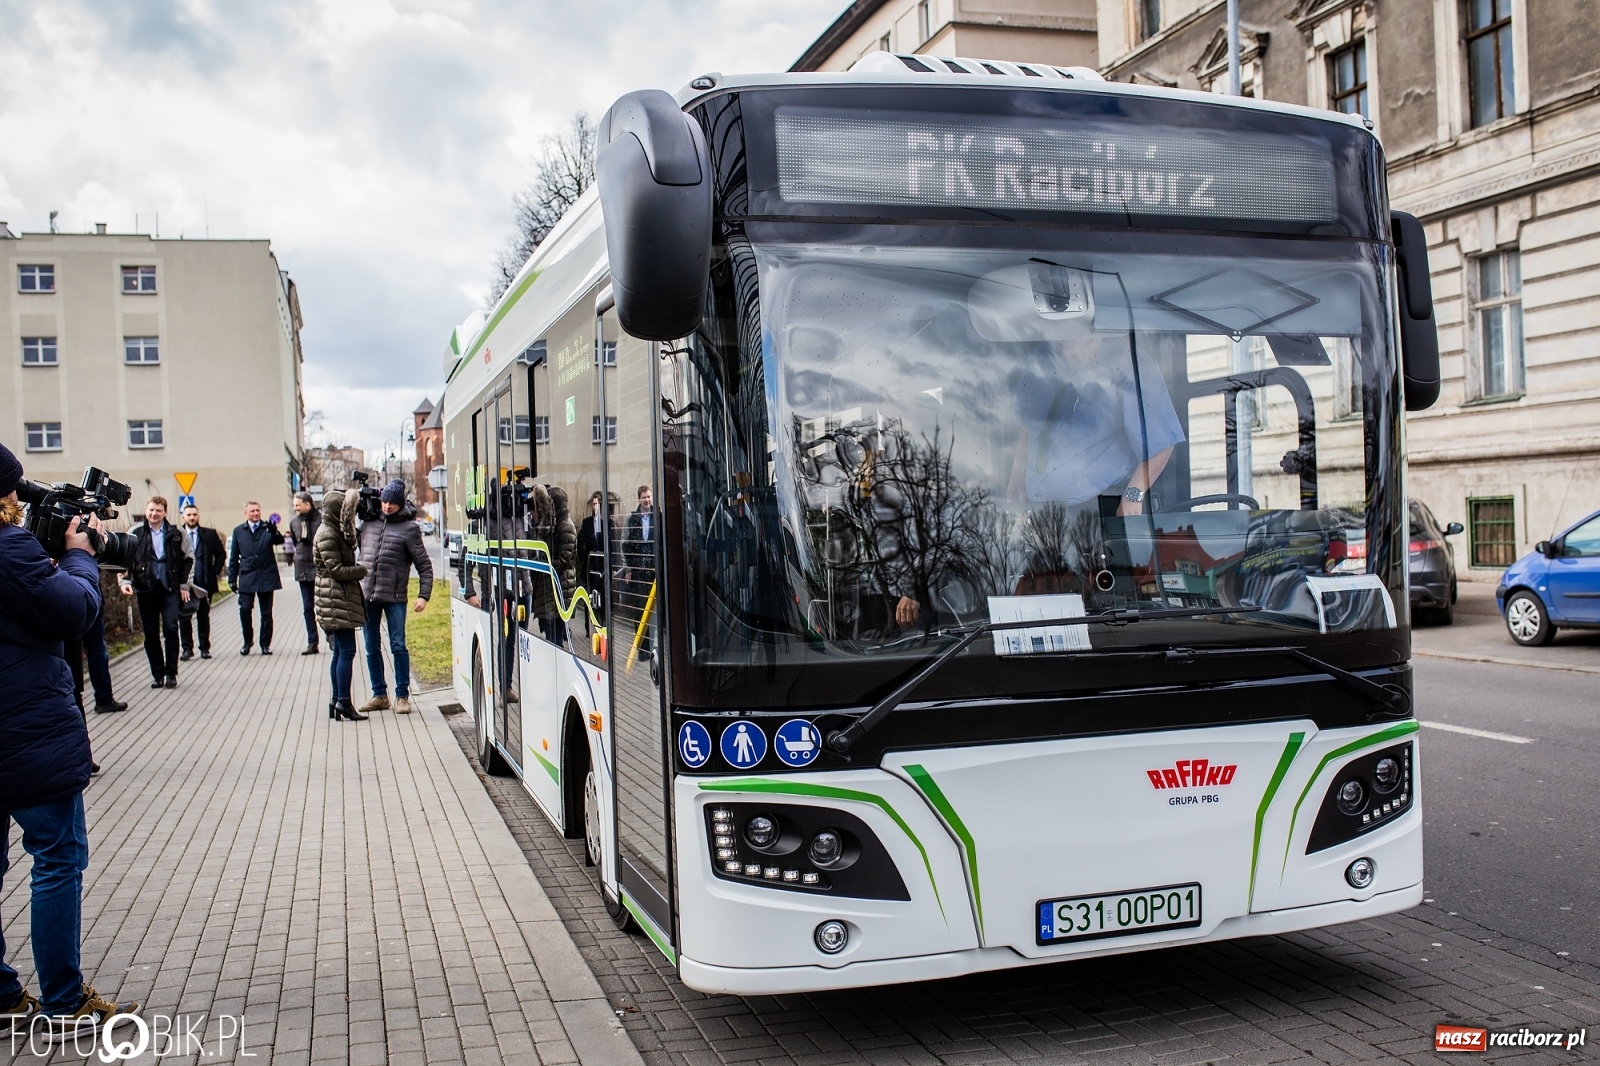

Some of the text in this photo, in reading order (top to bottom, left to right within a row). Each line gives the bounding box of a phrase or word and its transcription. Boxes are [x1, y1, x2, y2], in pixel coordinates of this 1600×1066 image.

[1146, 759, 1237, 789] RAFAKO
[1168, 794, 1219, 806] GRUPA PBG
[1057, 900, 1104, 934] S31
[1041, 924, 1052, 934] PL
